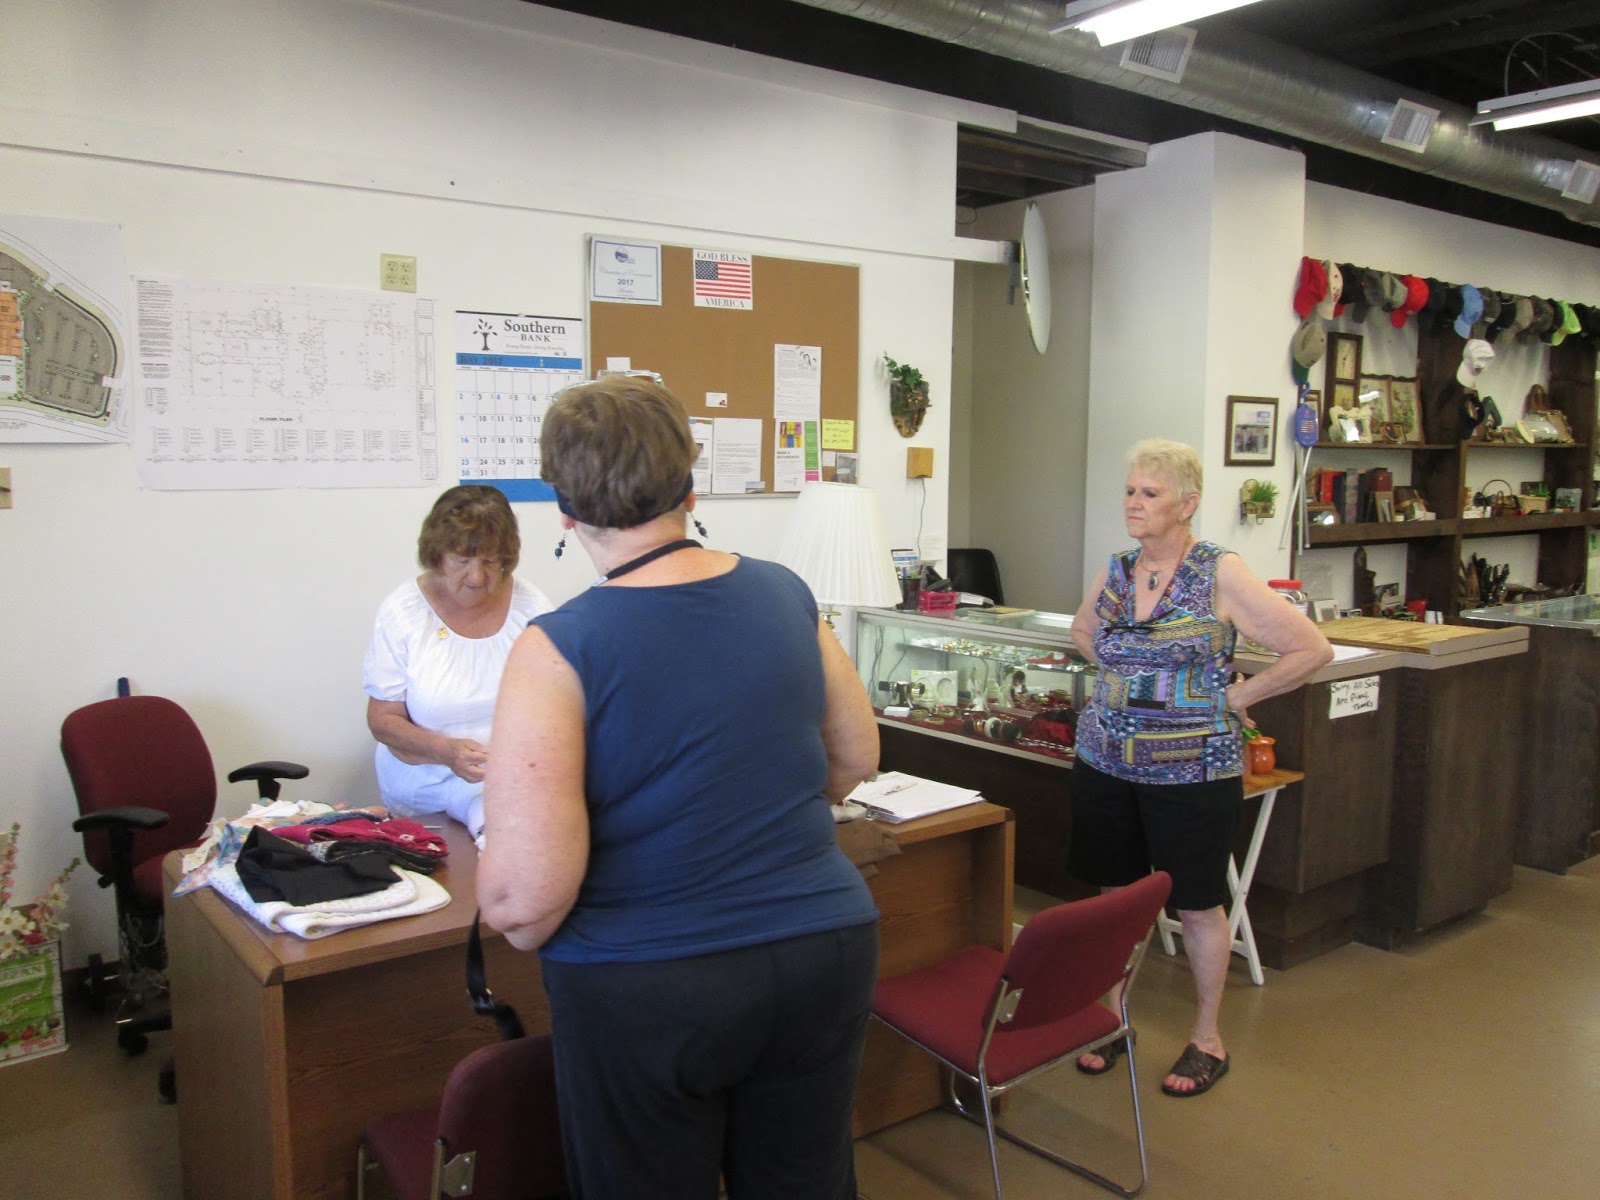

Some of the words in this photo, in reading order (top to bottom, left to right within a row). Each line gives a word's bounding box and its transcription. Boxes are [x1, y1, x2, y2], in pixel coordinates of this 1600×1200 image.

[697, 251, 718, 261] GOD
[720, 253, 748, 262] BLESS
[617, 278, 634, 286] 2017
[704, 297, 745, 308] AMERICA
[504, 319, 566, 334] Southern
[520, 334, 551, 342] BANK
[483, 356, 503, 366] 2017
